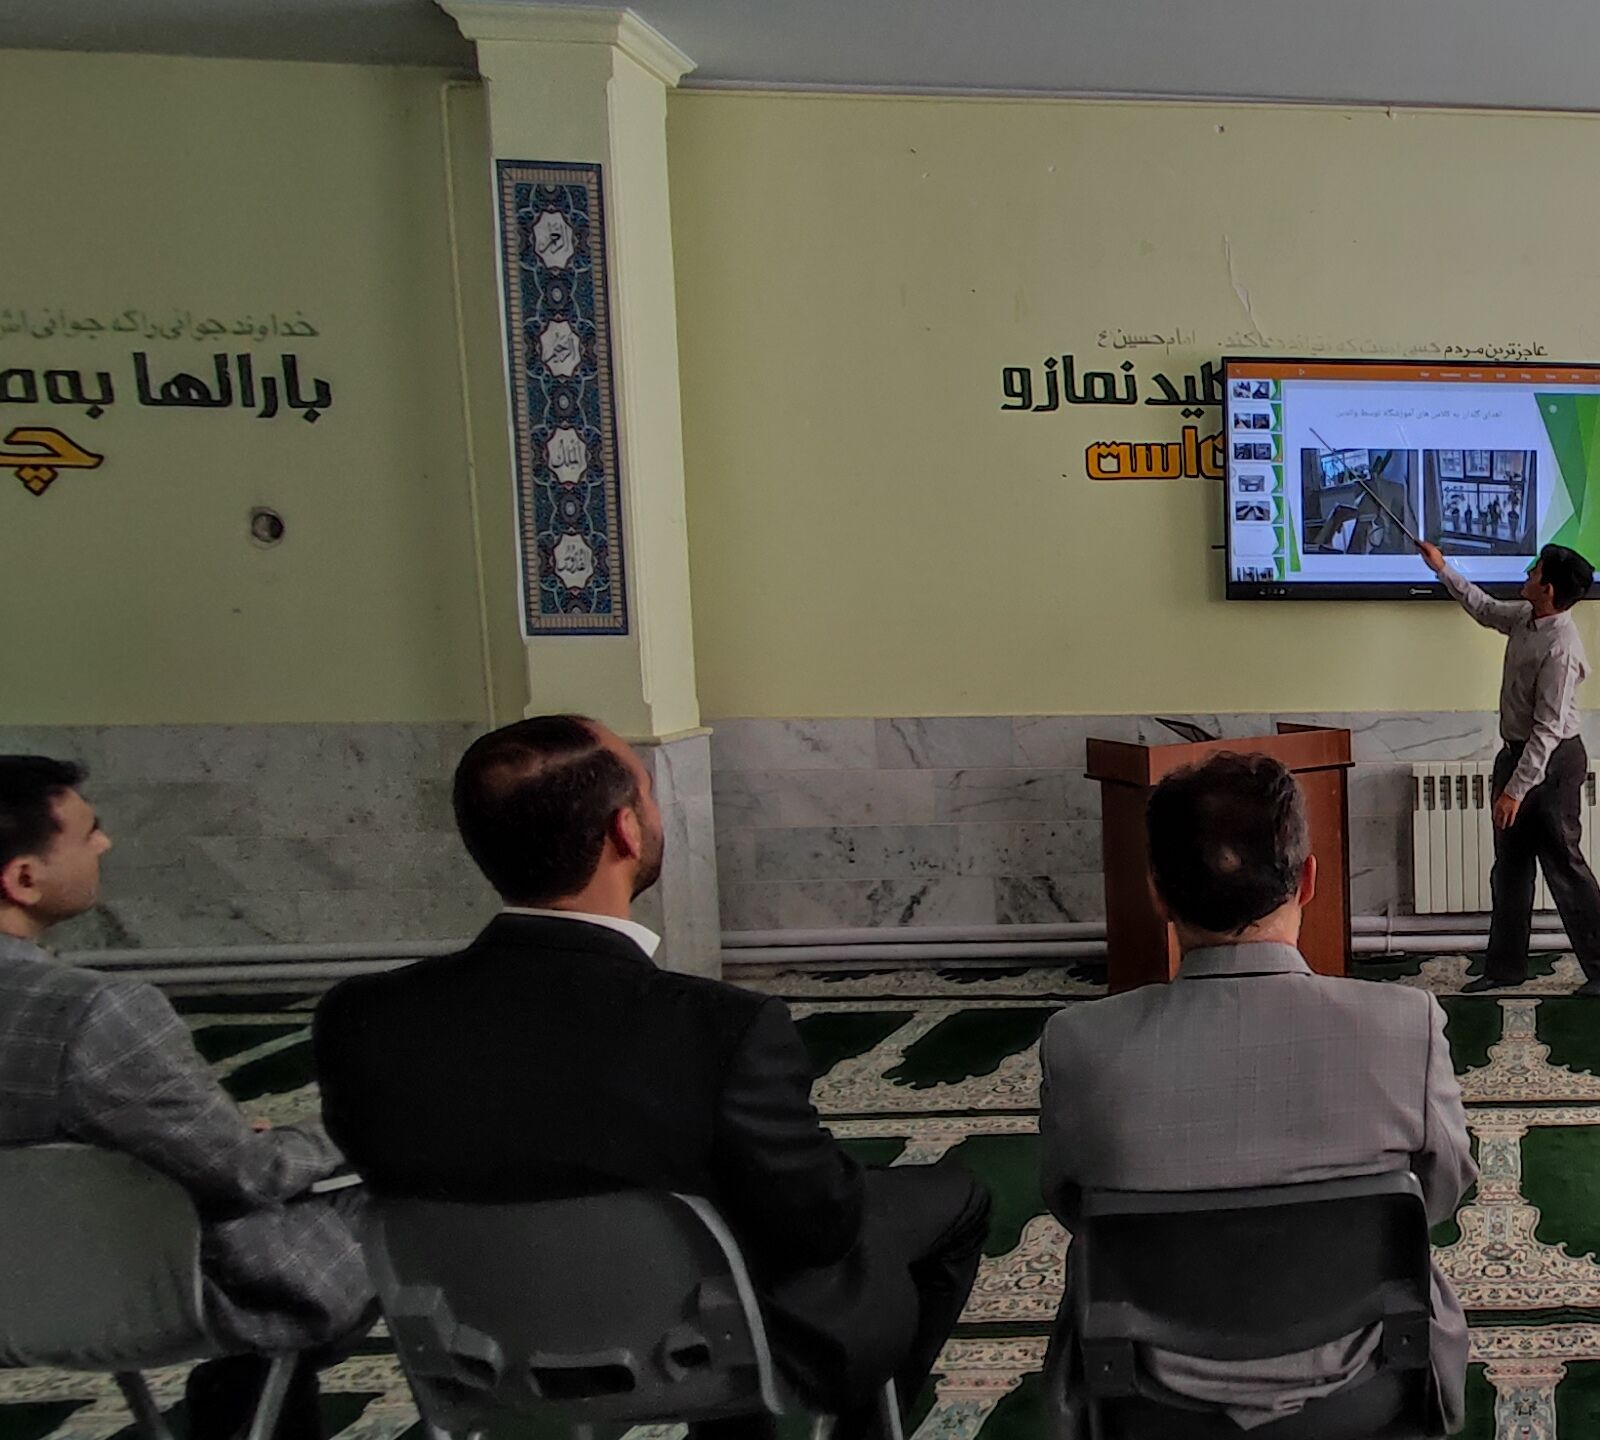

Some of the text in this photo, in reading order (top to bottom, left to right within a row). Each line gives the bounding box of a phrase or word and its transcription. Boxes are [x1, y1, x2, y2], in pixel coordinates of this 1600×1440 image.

[1111, 328, 1167, 350] حسین
[1444, 344, 1484, 360] مردم
[1144, 361, 1224, 419] لید
